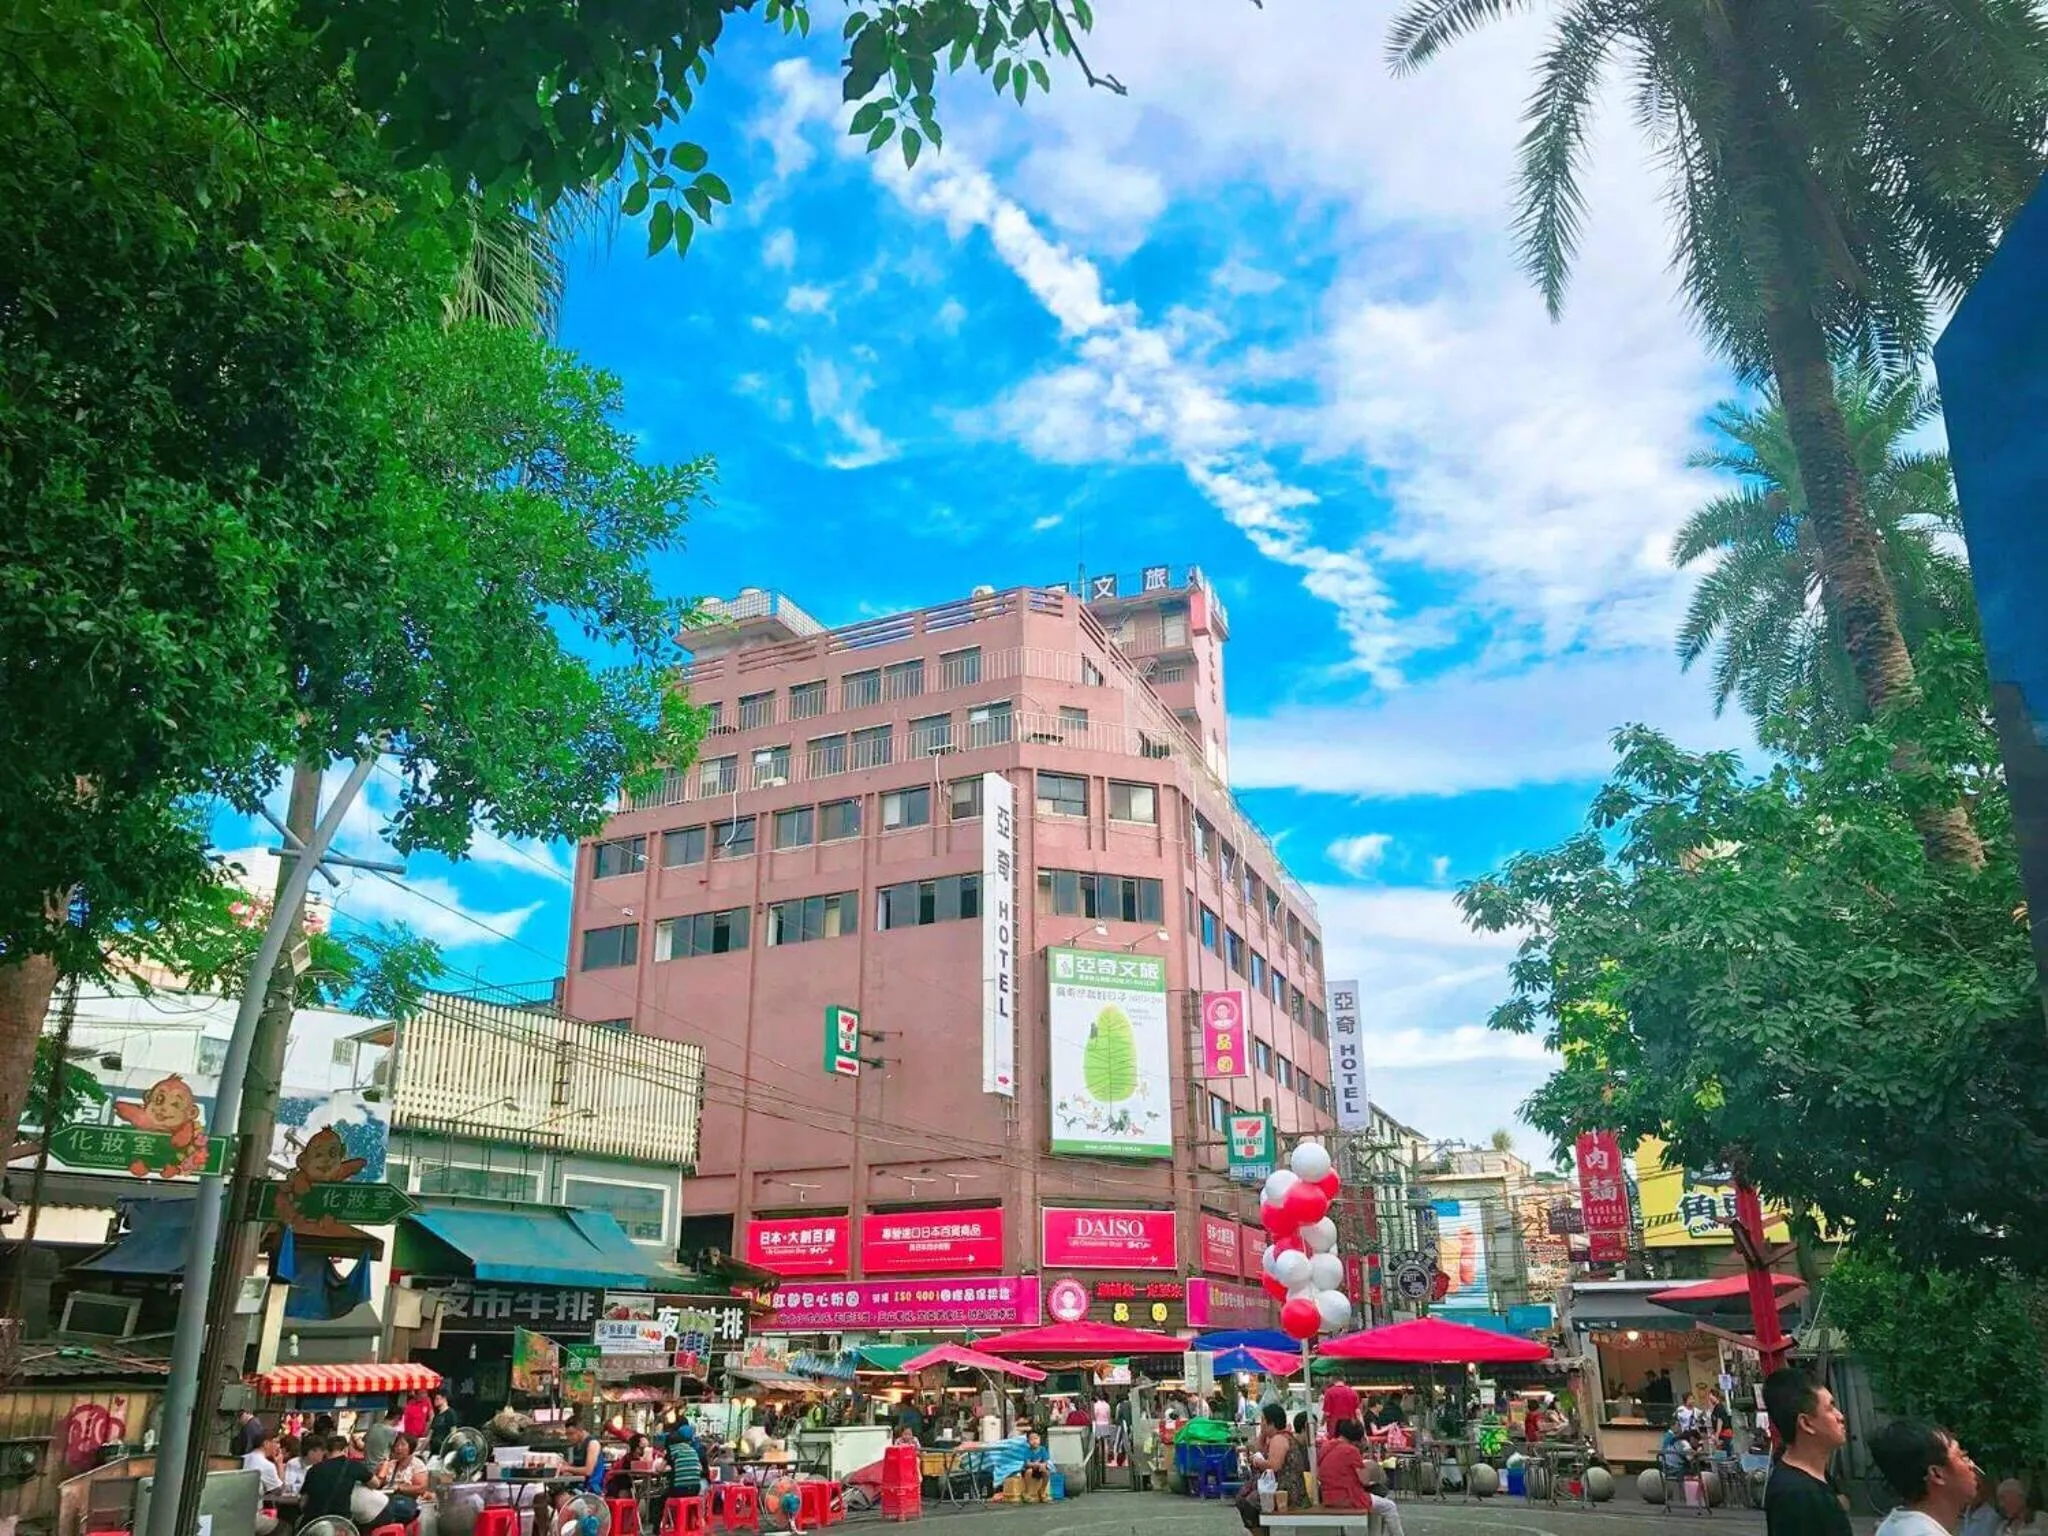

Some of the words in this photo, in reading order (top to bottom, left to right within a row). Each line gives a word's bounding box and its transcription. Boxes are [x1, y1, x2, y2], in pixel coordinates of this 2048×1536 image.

[999, 899, 1009, 1019] HOTEL
[1076, 956, 1160, 980] 亞奇文旅
[1334, 992, 1355, 1034] 亞奇
[1340, 1044, 1359, 1113] HOTEL
[1235, 1120, 1261, 1137] 7
[1077, 1217, 1145, 1237] DAISO
[428, 1278, 595, 1321] 夜市牛排
[656, 1306, 744, 1340] 夜排
